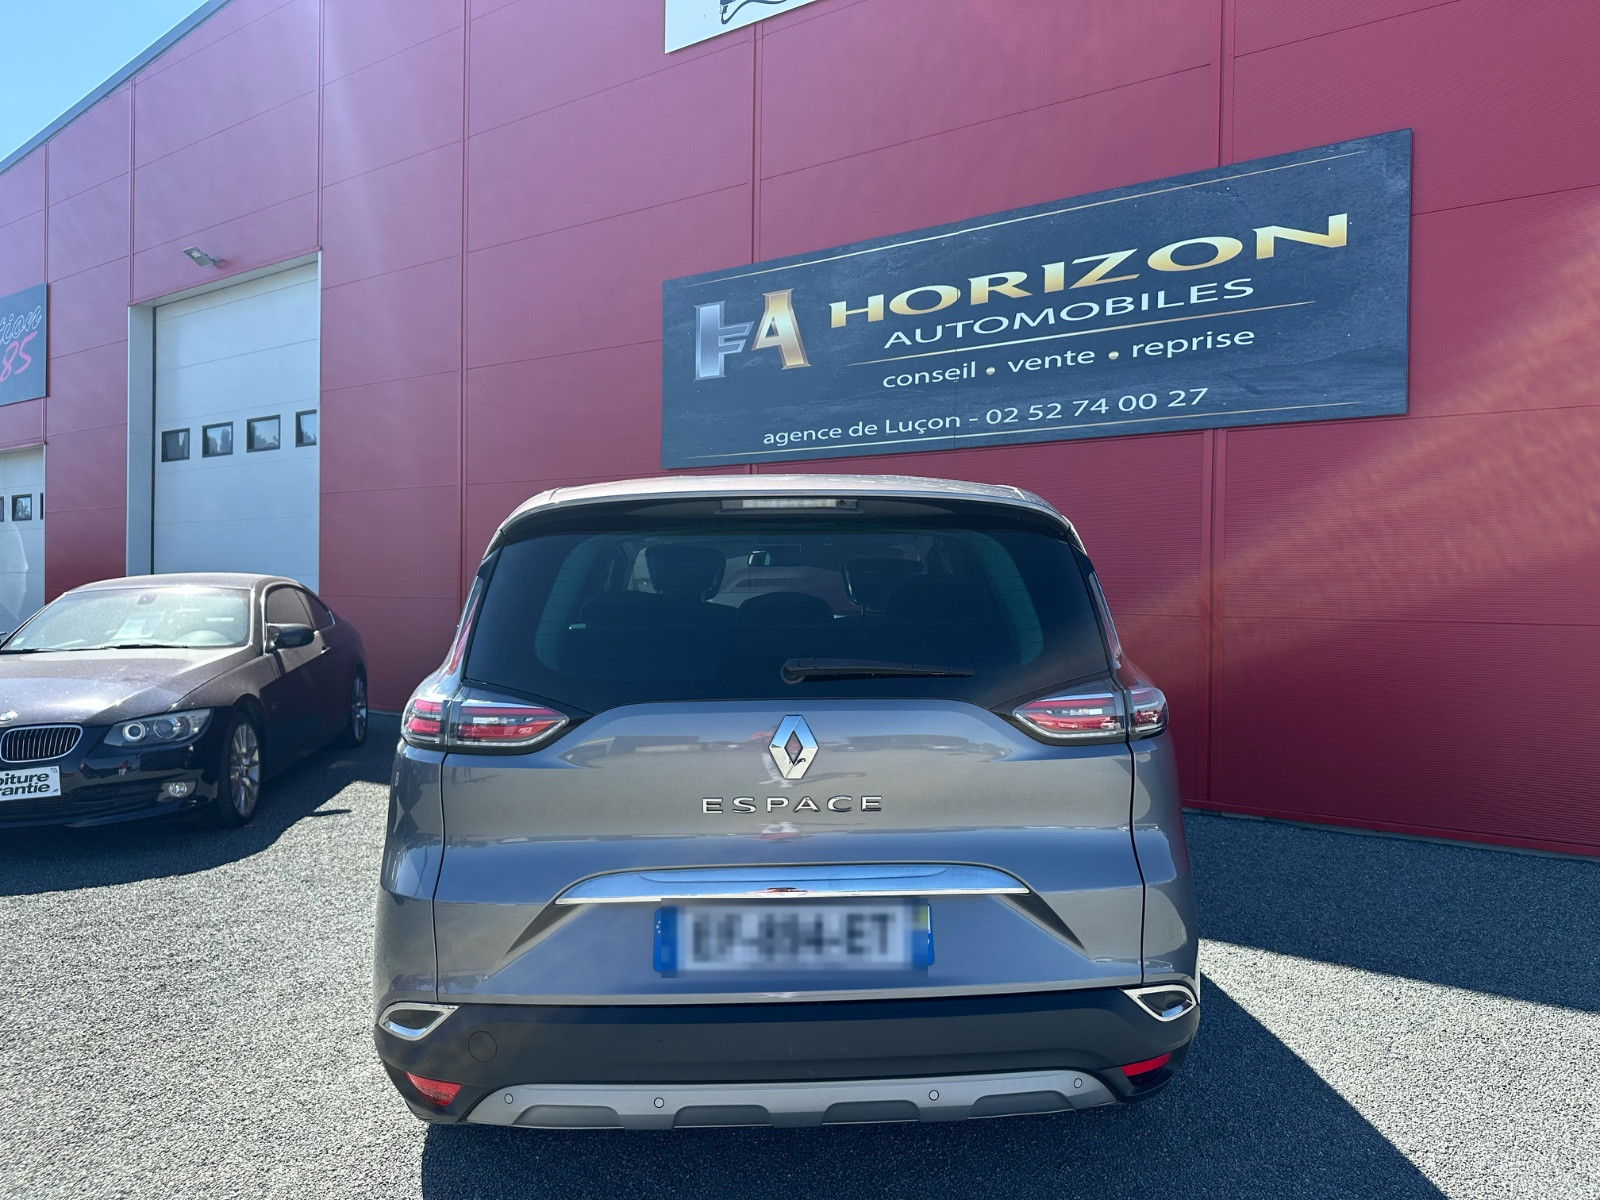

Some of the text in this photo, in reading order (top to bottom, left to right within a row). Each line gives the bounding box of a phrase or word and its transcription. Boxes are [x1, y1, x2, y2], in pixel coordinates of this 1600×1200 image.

[829, 212, 1348, 329] HORIZON
[884, 278, 1254, 349] AUTOMOBILES
[0, 330, 38, 381] 85
[883, 330, 1255, 388] conseil vente reprise
[763, 427, 842, 447] agence
[848, 421, 878, 437] de
[885, 416, 960, 435] Luçon
[986, 407, 1019, 425] 02
[1027, 403, 1062, 421] 52
[1072, 398, 1109, 417] 74
[1118, 393, 1157, 412] 00
[1167, 387, 1208, 408] 27
[0, 782, 51, 796] antie
[702, 795, 882, 814] ESPACE
